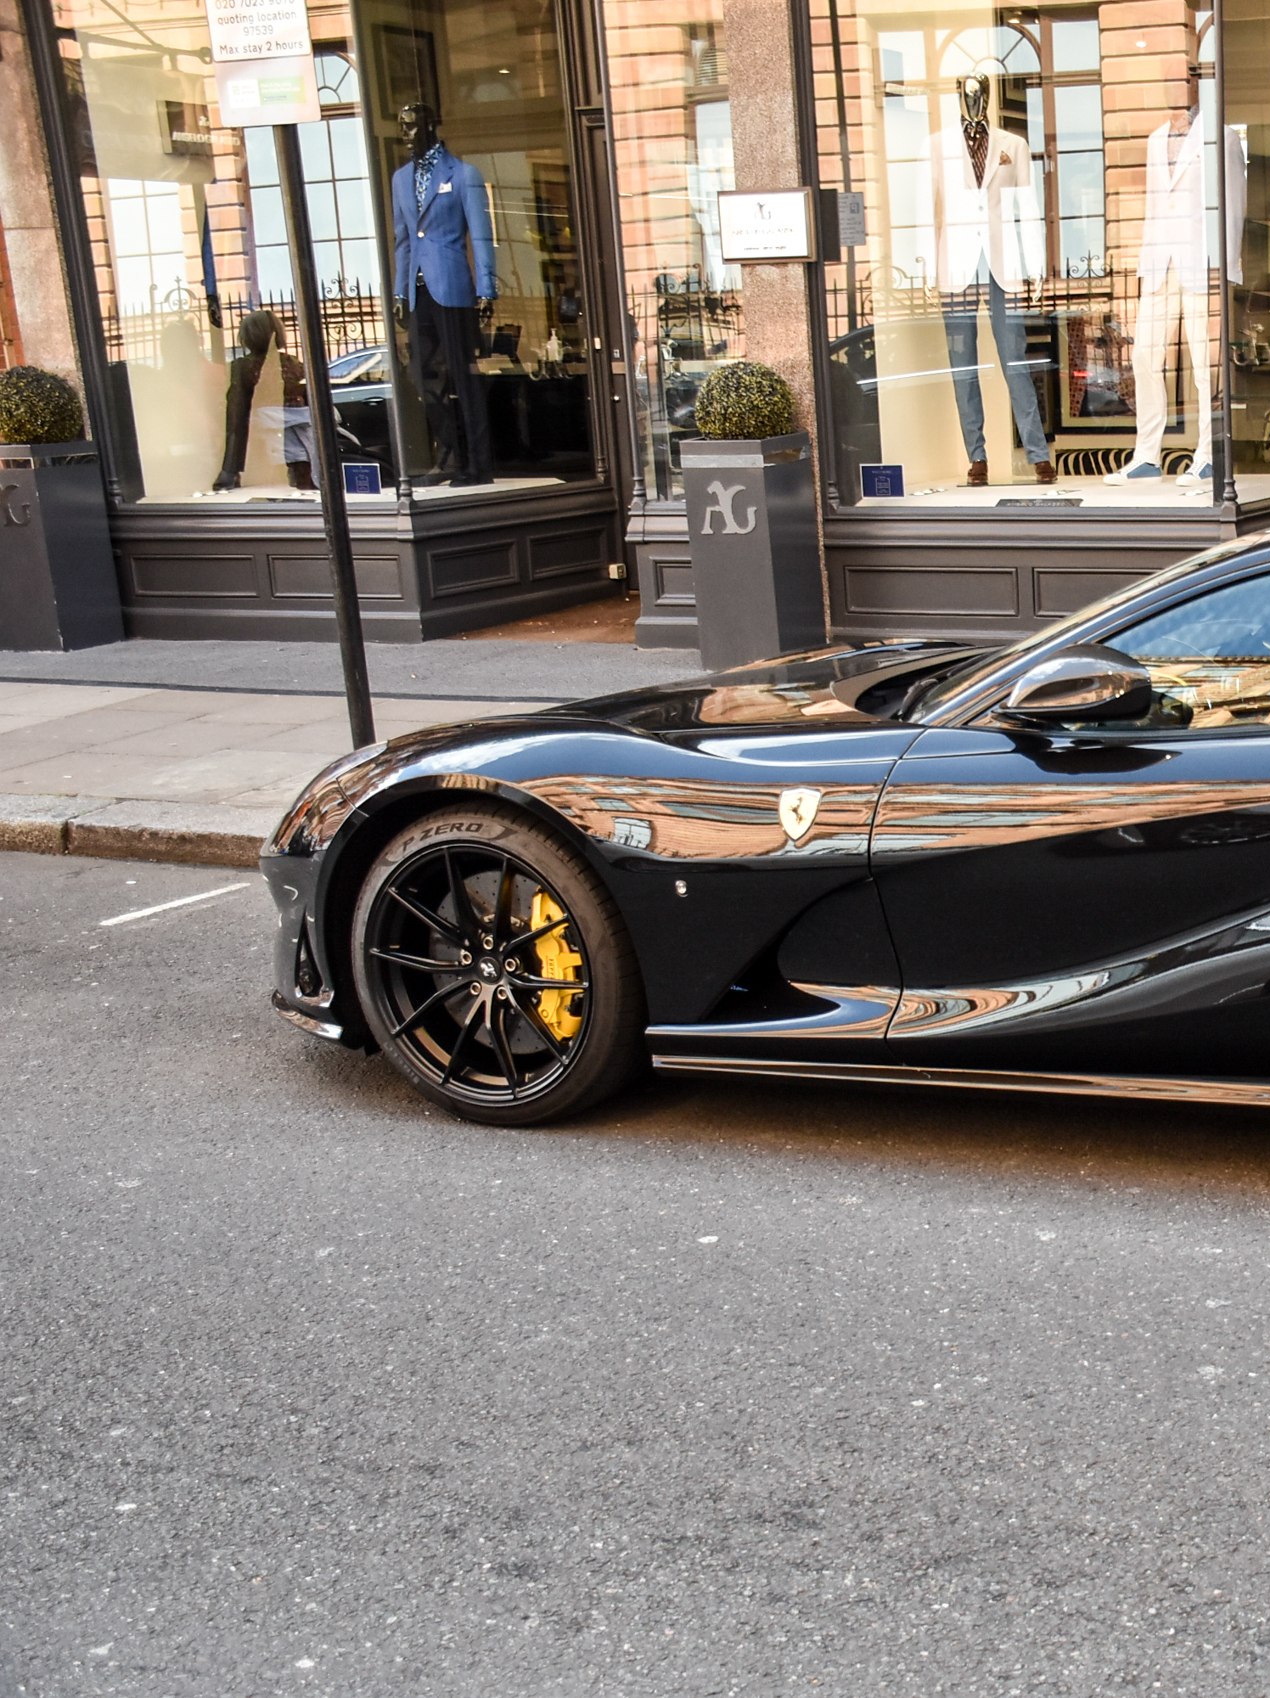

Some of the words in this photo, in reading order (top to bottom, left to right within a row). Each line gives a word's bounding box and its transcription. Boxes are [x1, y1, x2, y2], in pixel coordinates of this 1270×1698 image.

[217, 13, 254, 26] quoting
[257, 10, 298, 22] location
[243, 25, 274, 36] 97539
[219, 44, 240, 55] Max
[243, 42, 263, 54] stay
[265, 41, 272, 51] 2
[275, 40, 304, 51] hours
[403, 836, 415, 852] P
[420, 822, 484, 841] ZERO
